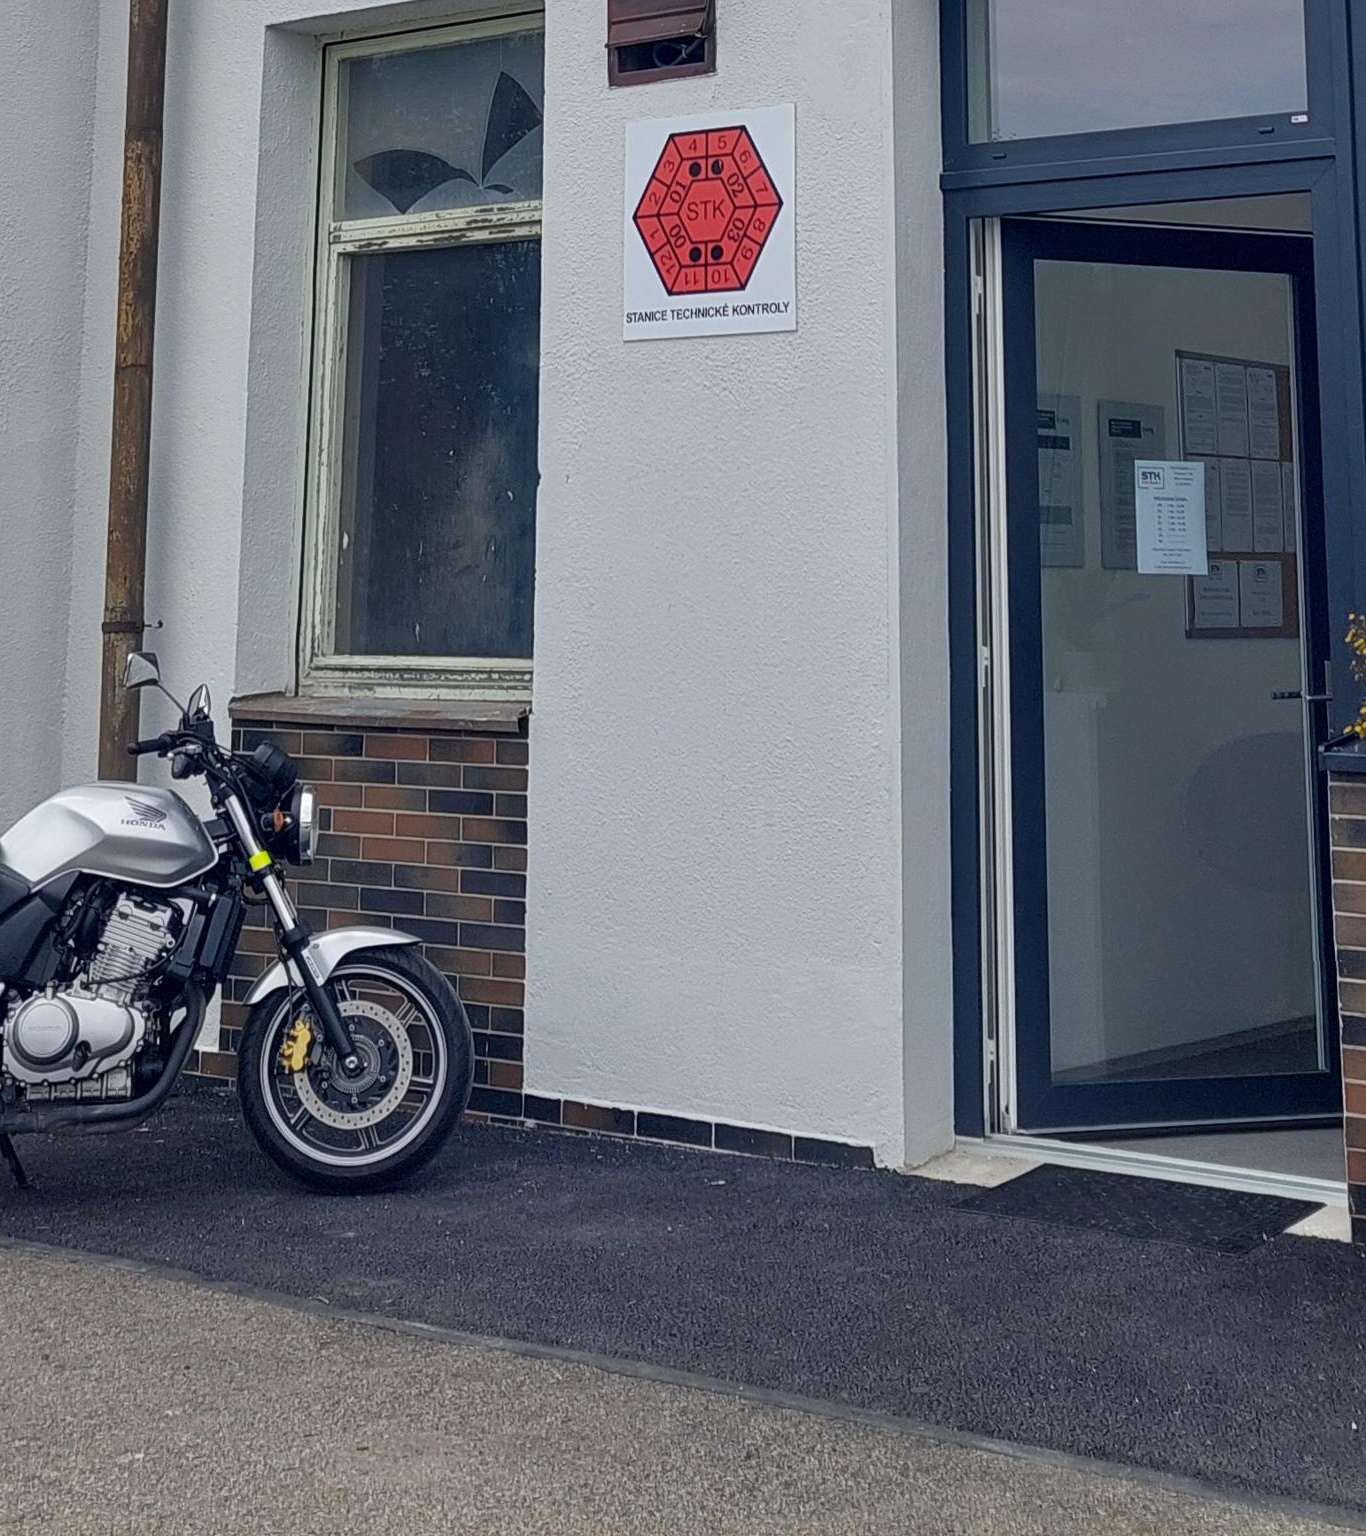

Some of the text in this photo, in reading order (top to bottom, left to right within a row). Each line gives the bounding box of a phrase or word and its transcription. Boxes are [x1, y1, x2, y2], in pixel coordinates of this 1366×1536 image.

[688, 137, 698, 153] 4
[717, 135, 728, 150] 5
[663, 159, 675, 173] 3
[669, 180, 687, 204] 01
[726, 172, 745, 198] 02
[755, 182, 768, 193] 7
[648, 191, 662, 207] 2
[686, 199, 726, 222] STK
[727, 217, 745, 243] 03
[752, 217, 766, 232] 8
[649, 228, 660, 240] 1
[669, 224, 687, 249] 00
[660, 250, 676, 276] 12
[684, 270, 700, 286] 11
[711, 268, 730, 284] 10
[626, 301, 791, 324] STANICE TECHNICKÉ KONTROLY
[1141, 471, 1162, 481] STK
[120, 819, 166, 831] HONDA
